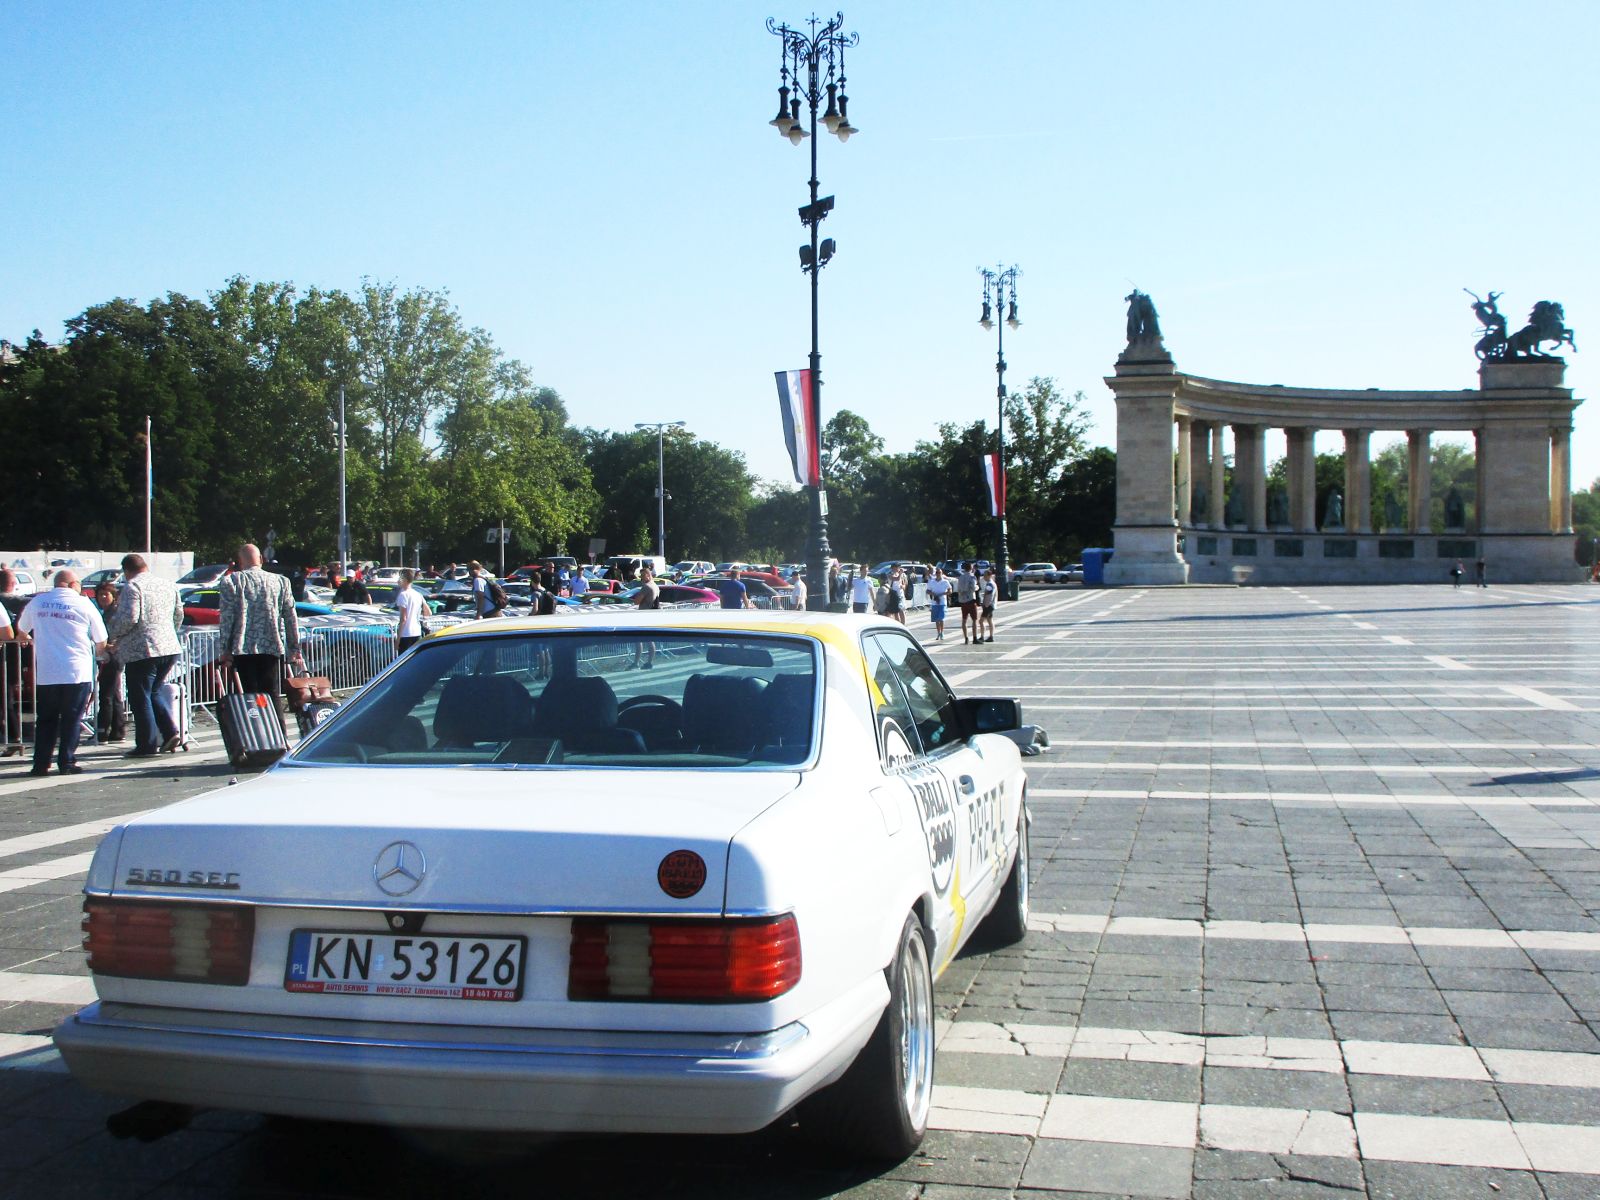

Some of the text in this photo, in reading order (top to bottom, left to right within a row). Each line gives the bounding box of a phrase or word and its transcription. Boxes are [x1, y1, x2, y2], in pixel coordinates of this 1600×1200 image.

[914, 780, 950, 821] BALL
[930, 819, 954, 868] 3000
[127, 868, 241, 887] 560 SEC
[292, 963, 306, 975] PL
[312, 936, 517, 986] KN 53126
[326, 983, 369, 992] AUTO SERWIS
